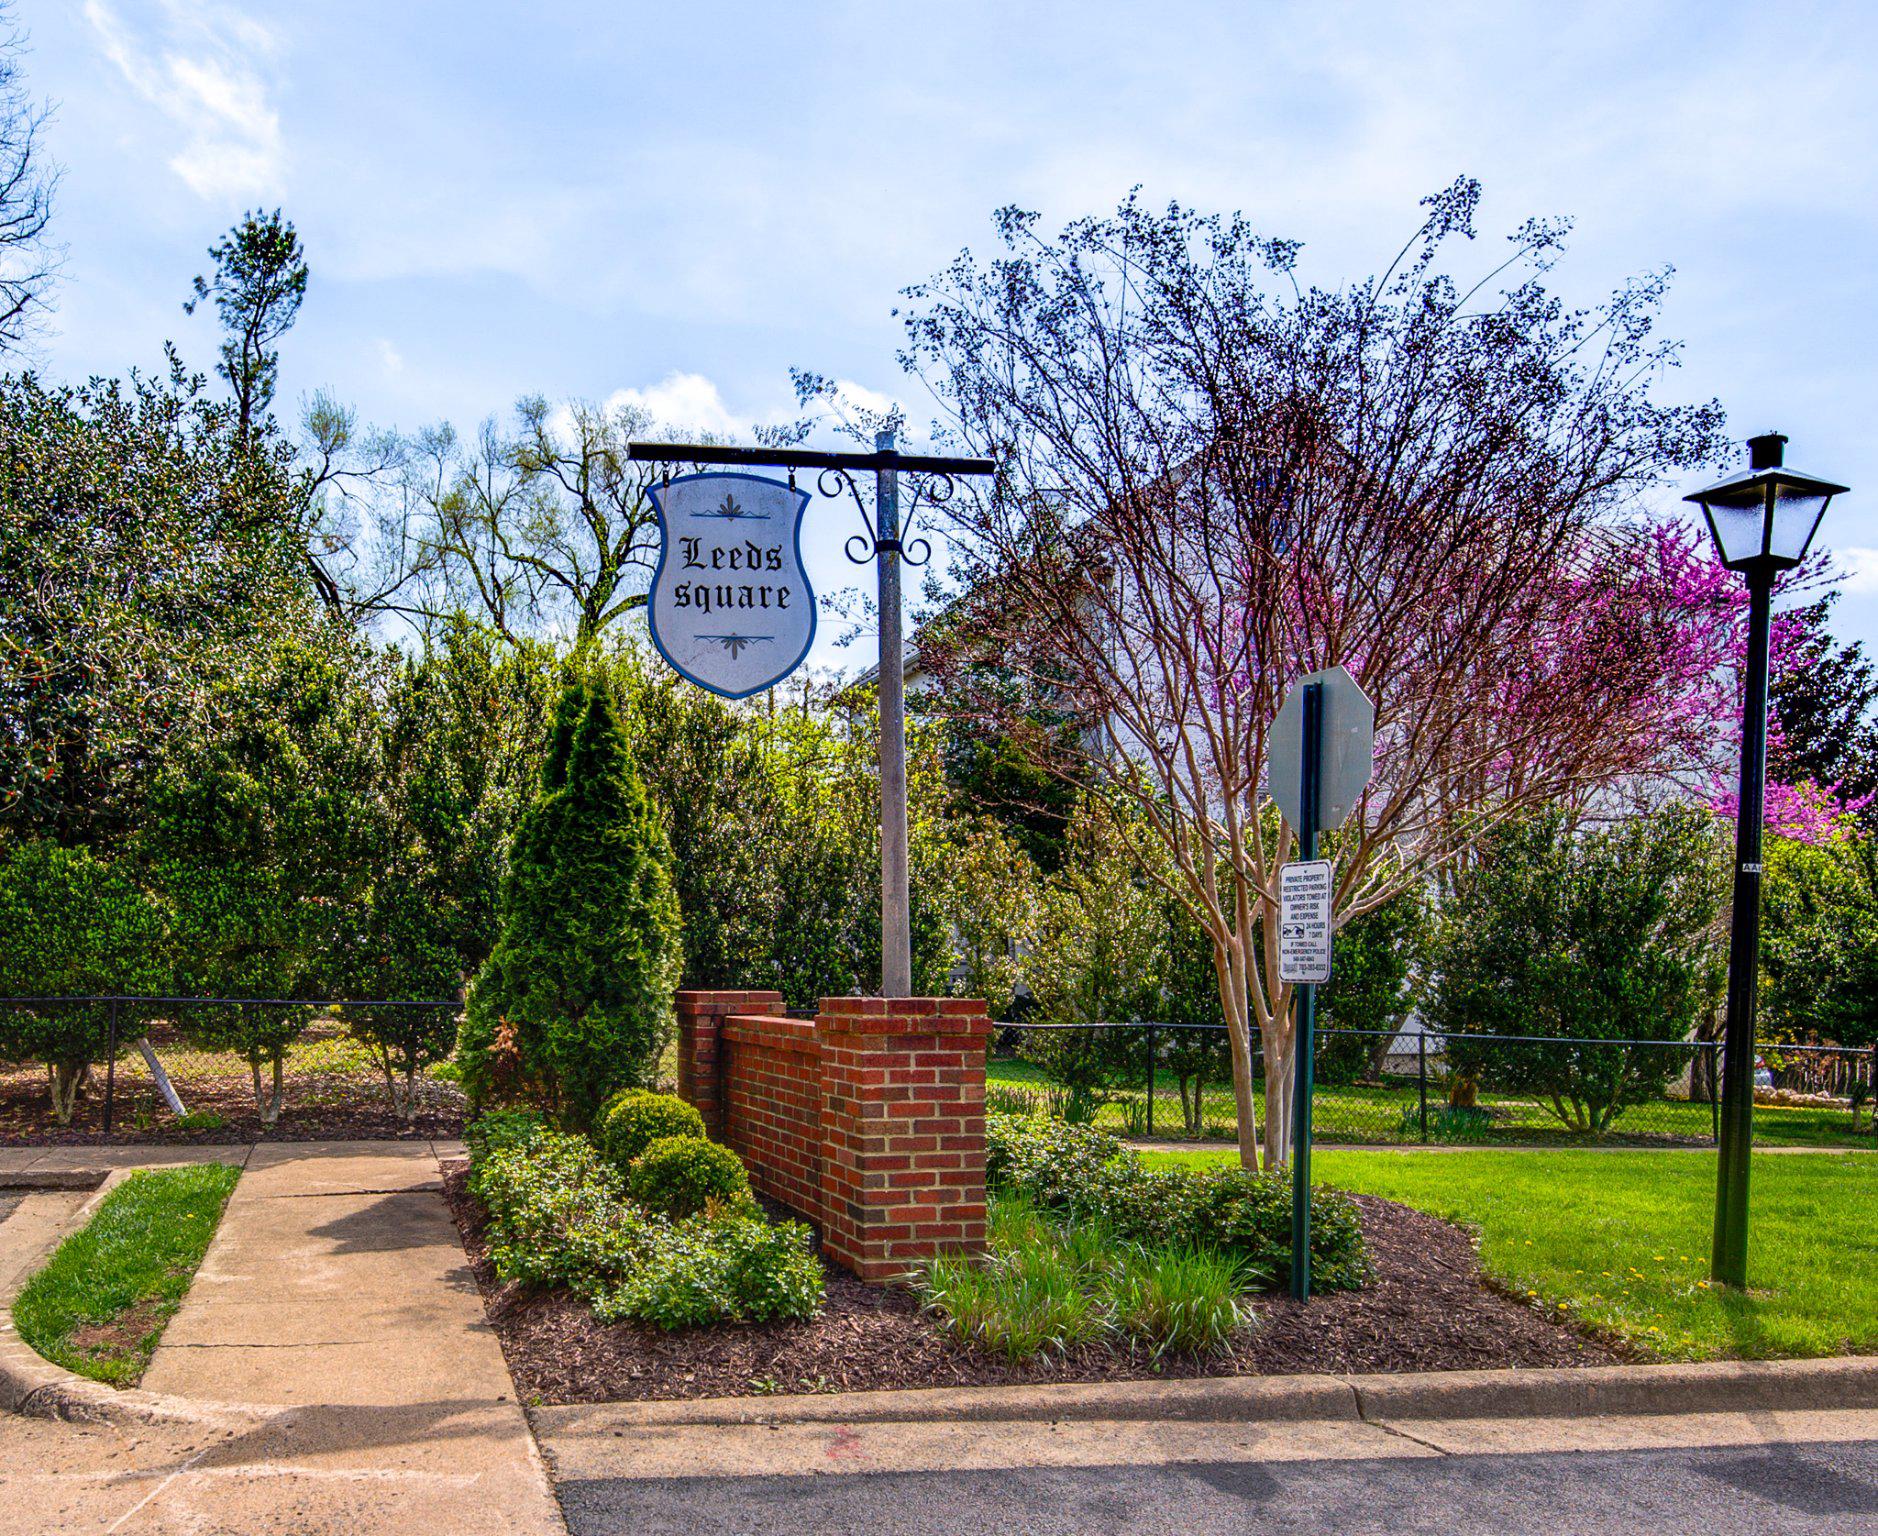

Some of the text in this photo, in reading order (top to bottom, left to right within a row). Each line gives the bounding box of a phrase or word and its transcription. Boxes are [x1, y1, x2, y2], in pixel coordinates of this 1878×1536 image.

[679, 537, 782, 571] Leeds
[674, 581, 791, 615] square
[1285, 874, 1325, 883] PRIVATE PROPERTY
[1283, 883, 1327, 892] RESTRICTED PARKING
[1283, 894, 1305, 902] VIOLATORS
[1321, 892, 1327, 900] AT
[1309, 902, 1319, 910] RISK
[1300, 911, 1318, 920] EXPENSE
